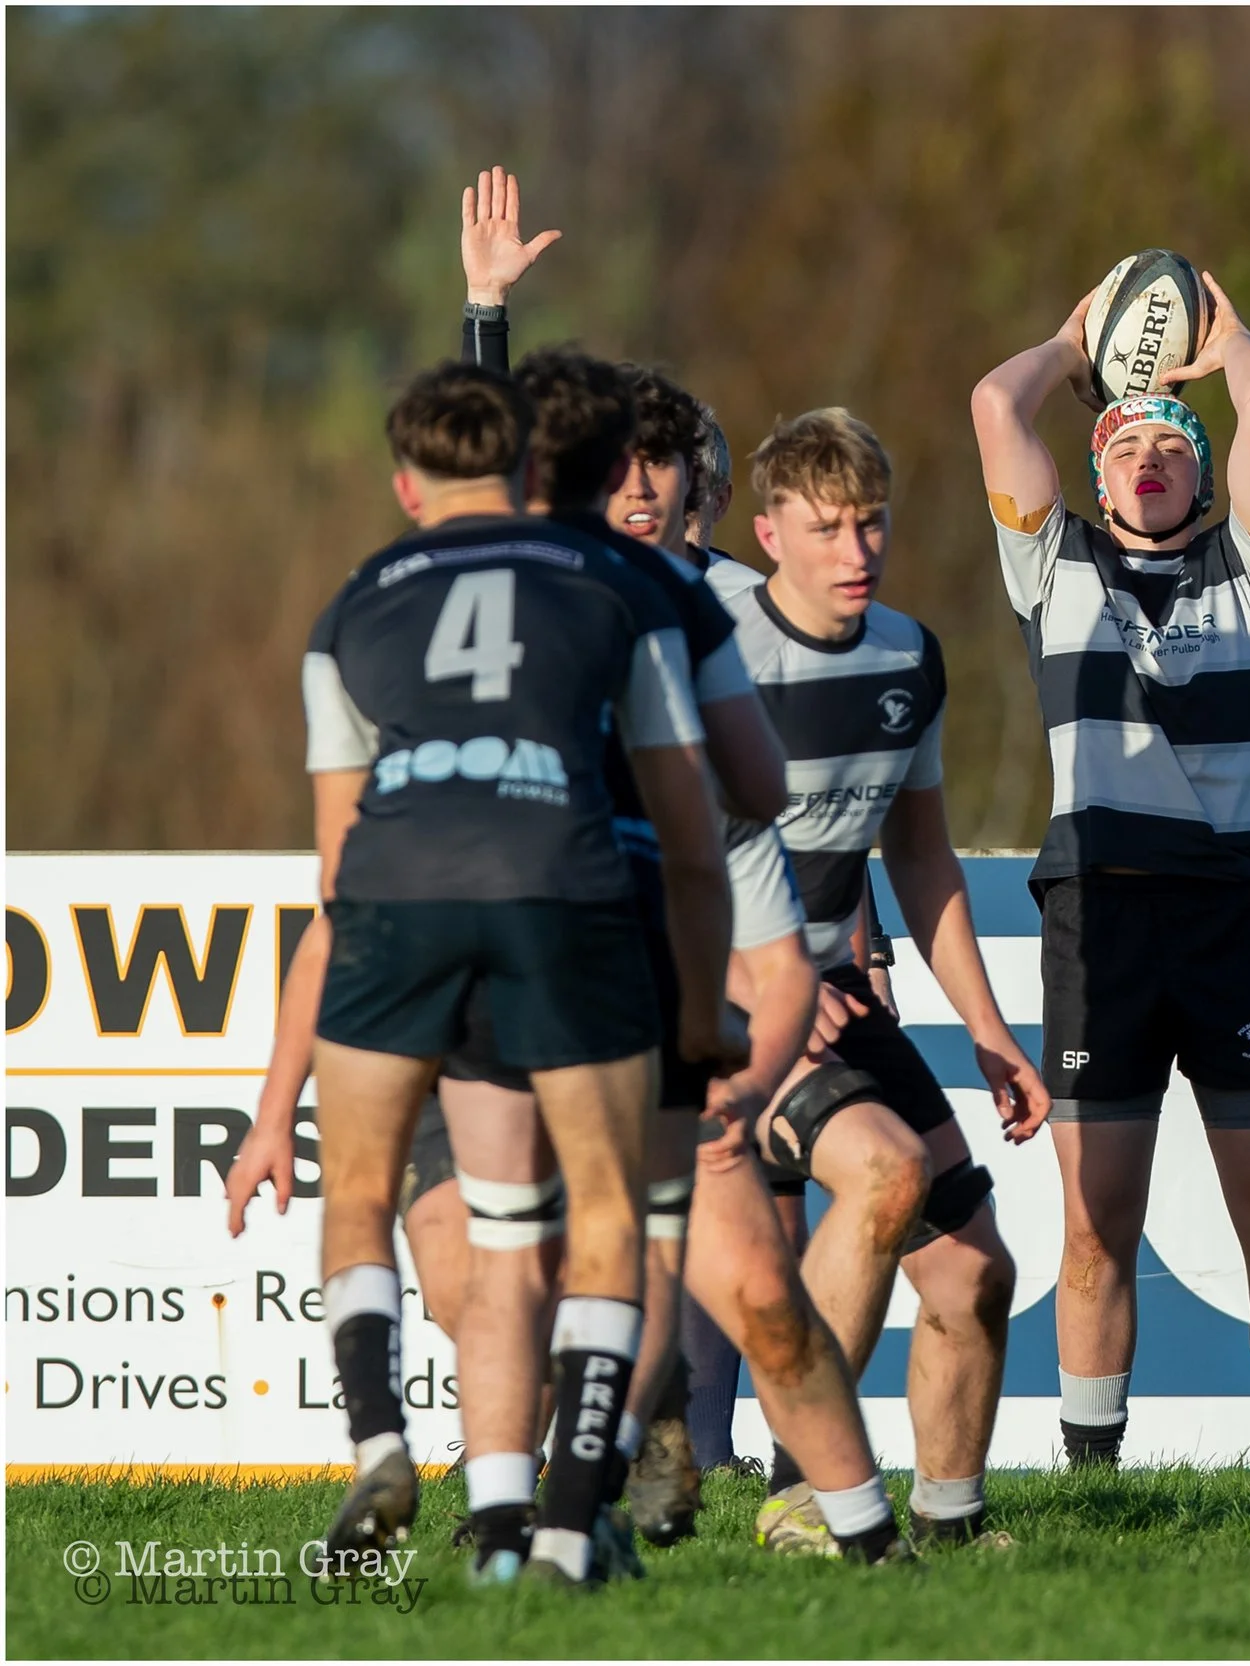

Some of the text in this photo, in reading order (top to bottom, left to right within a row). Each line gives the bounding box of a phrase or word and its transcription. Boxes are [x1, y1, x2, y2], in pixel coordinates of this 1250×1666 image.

[1124, 293, 1171, 398] LBERT
[425, 568, 525, 702] 4
[1113, 613, 1217, 645] FENDER
[787, 783, 897, 807] EFENDE
[1062, 1051, 1090, 1070] SP
[5, 1273, 186, 1323] nsions
[36, 1357, 228, 1410] Drives
[570, 1355, 619, 1462] PRFC
